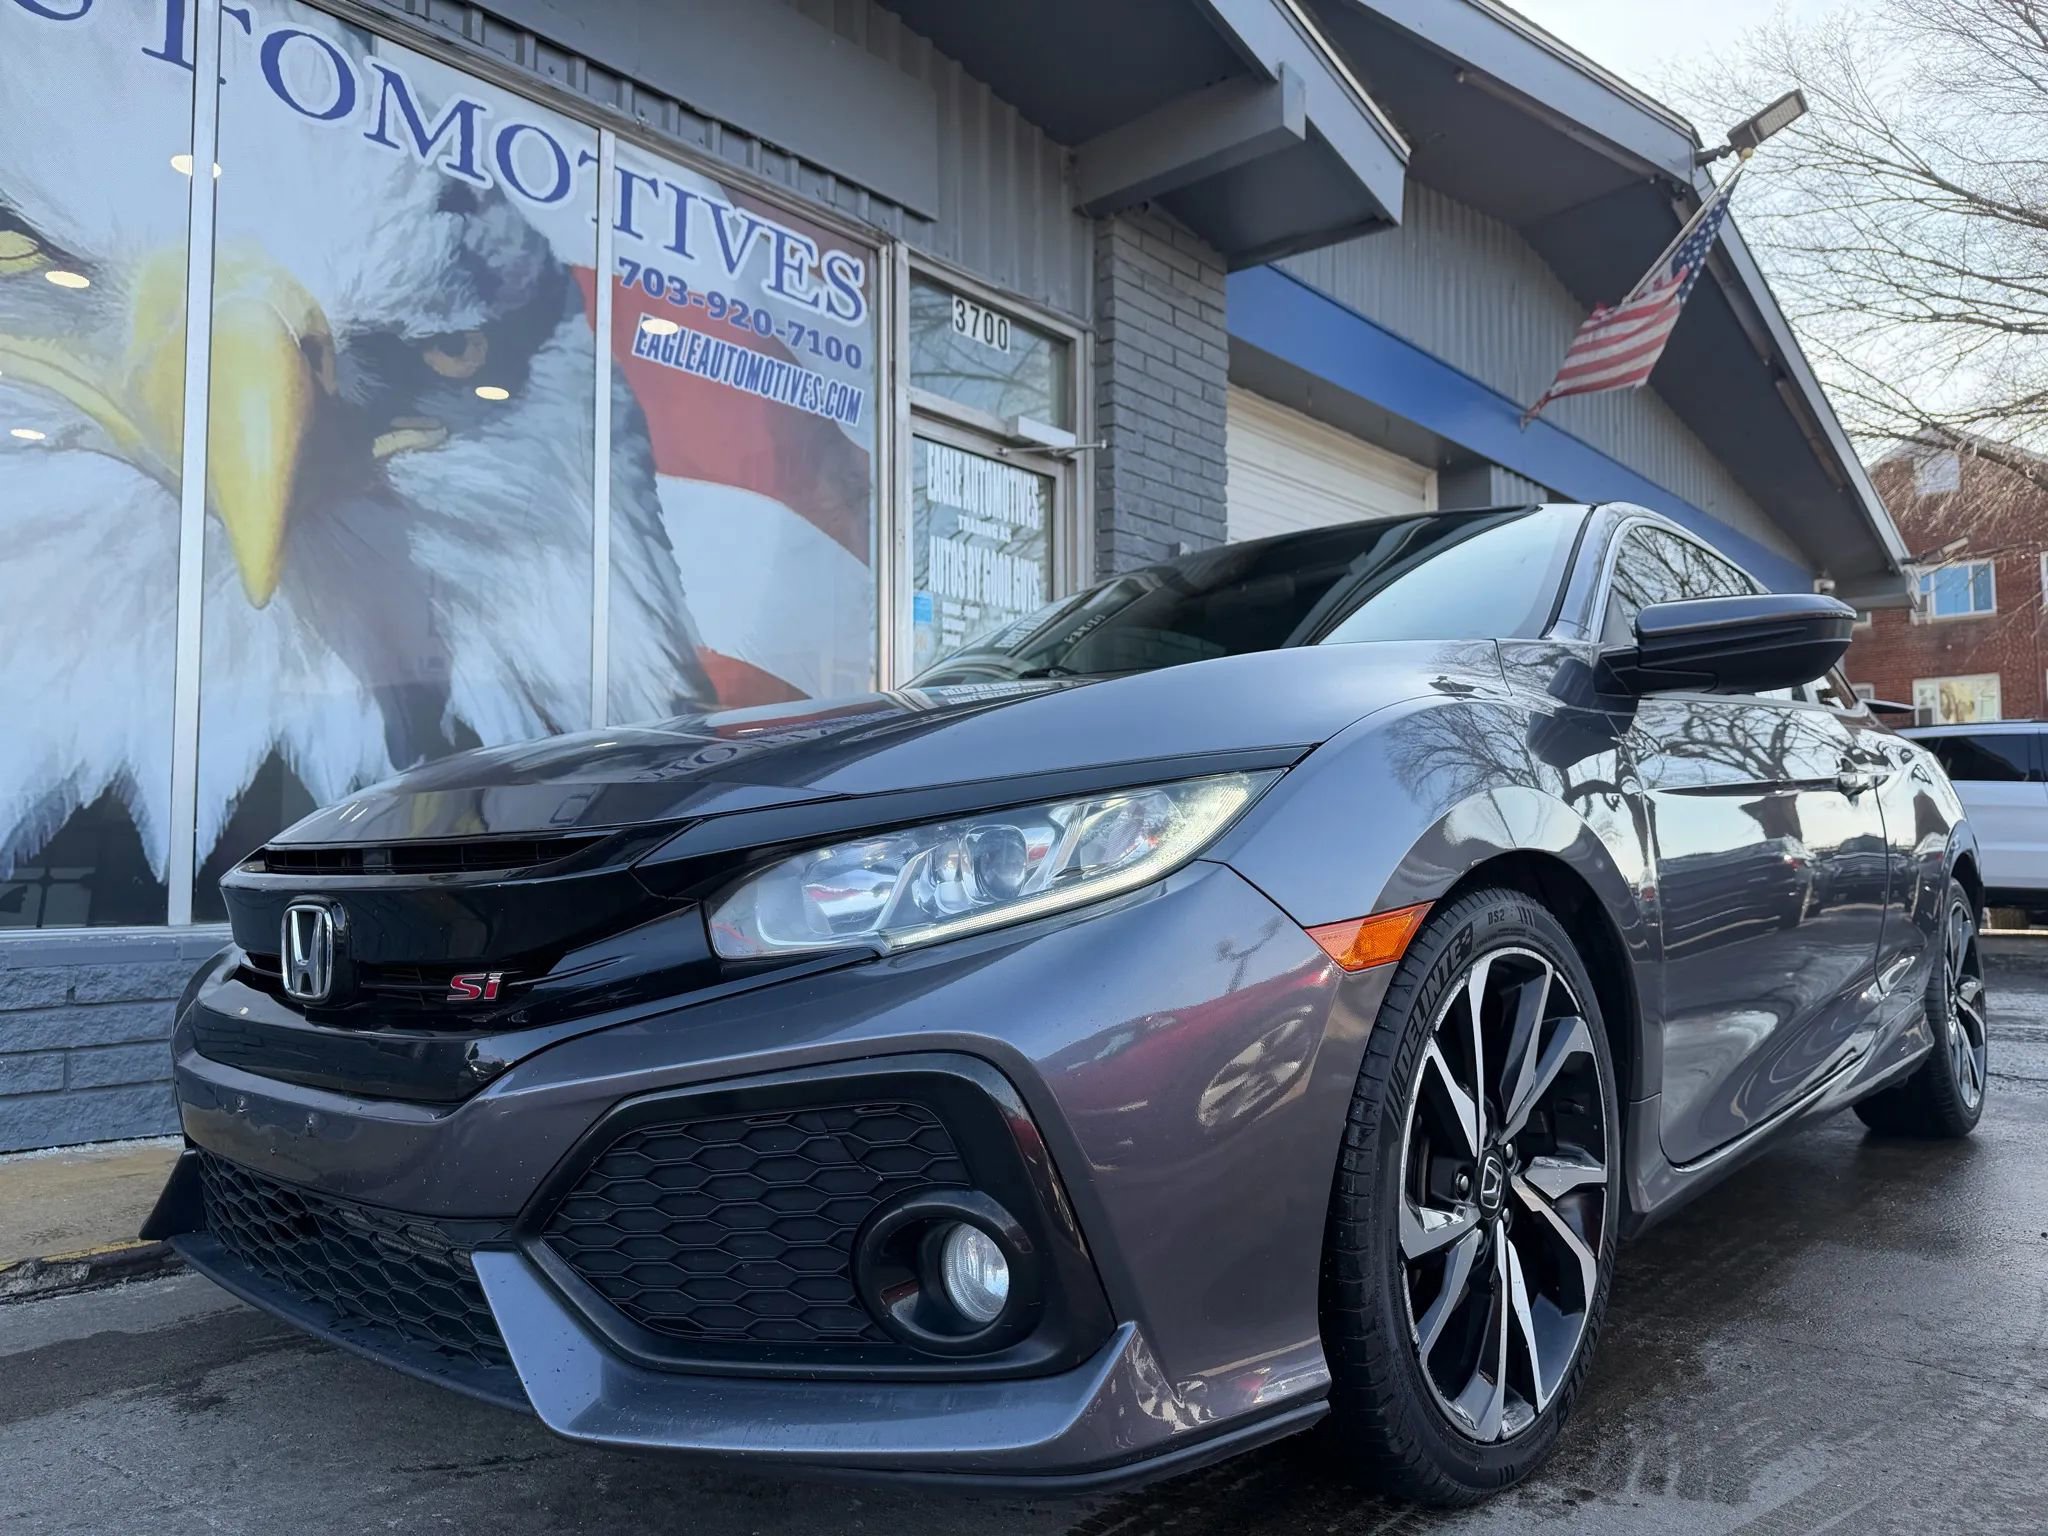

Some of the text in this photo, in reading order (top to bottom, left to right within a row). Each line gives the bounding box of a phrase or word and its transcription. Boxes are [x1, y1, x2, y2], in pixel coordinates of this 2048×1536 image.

[12, 0, 862, 322] TOMOTIVES
[618, 256, 862, 370] 703-920-7100
[956, 299, 1007, 351] 3700
[633, 316, 863, 425] EAGLEAUTOMOTIVES.COM
[927, 442, 1039, 530] EAGLE AUTOMOTIVES
[929, 535, 1040, 613] AUTOS BY GOOD GUYS
[447, 972, 504, 1001] Si
[1399, 937, 1463, 1081] DELINTE
